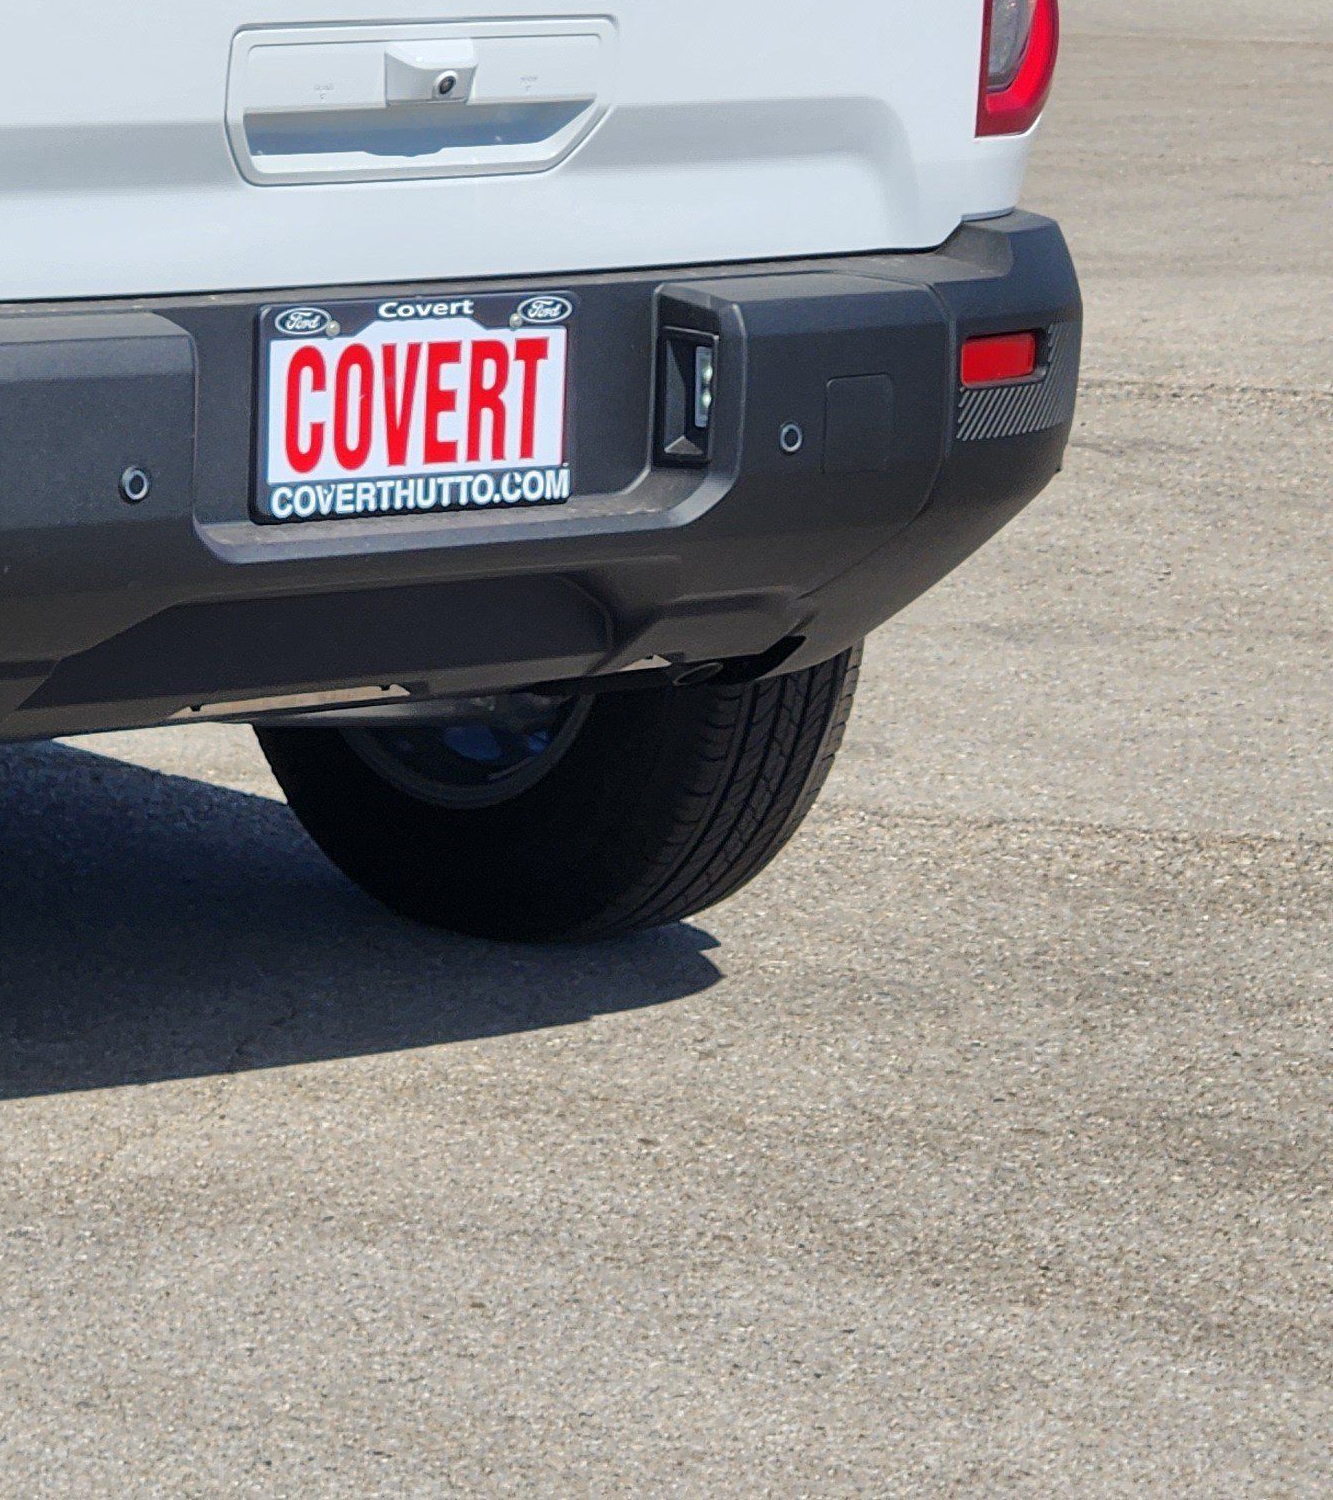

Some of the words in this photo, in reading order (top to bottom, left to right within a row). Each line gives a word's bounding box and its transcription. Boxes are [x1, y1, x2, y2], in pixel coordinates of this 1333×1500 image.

[378, 299, 475, 318] Covert
[285, 336, 550, 473] COVERT
[270, 467, 571, 519] COVERTHUTTO.COM
